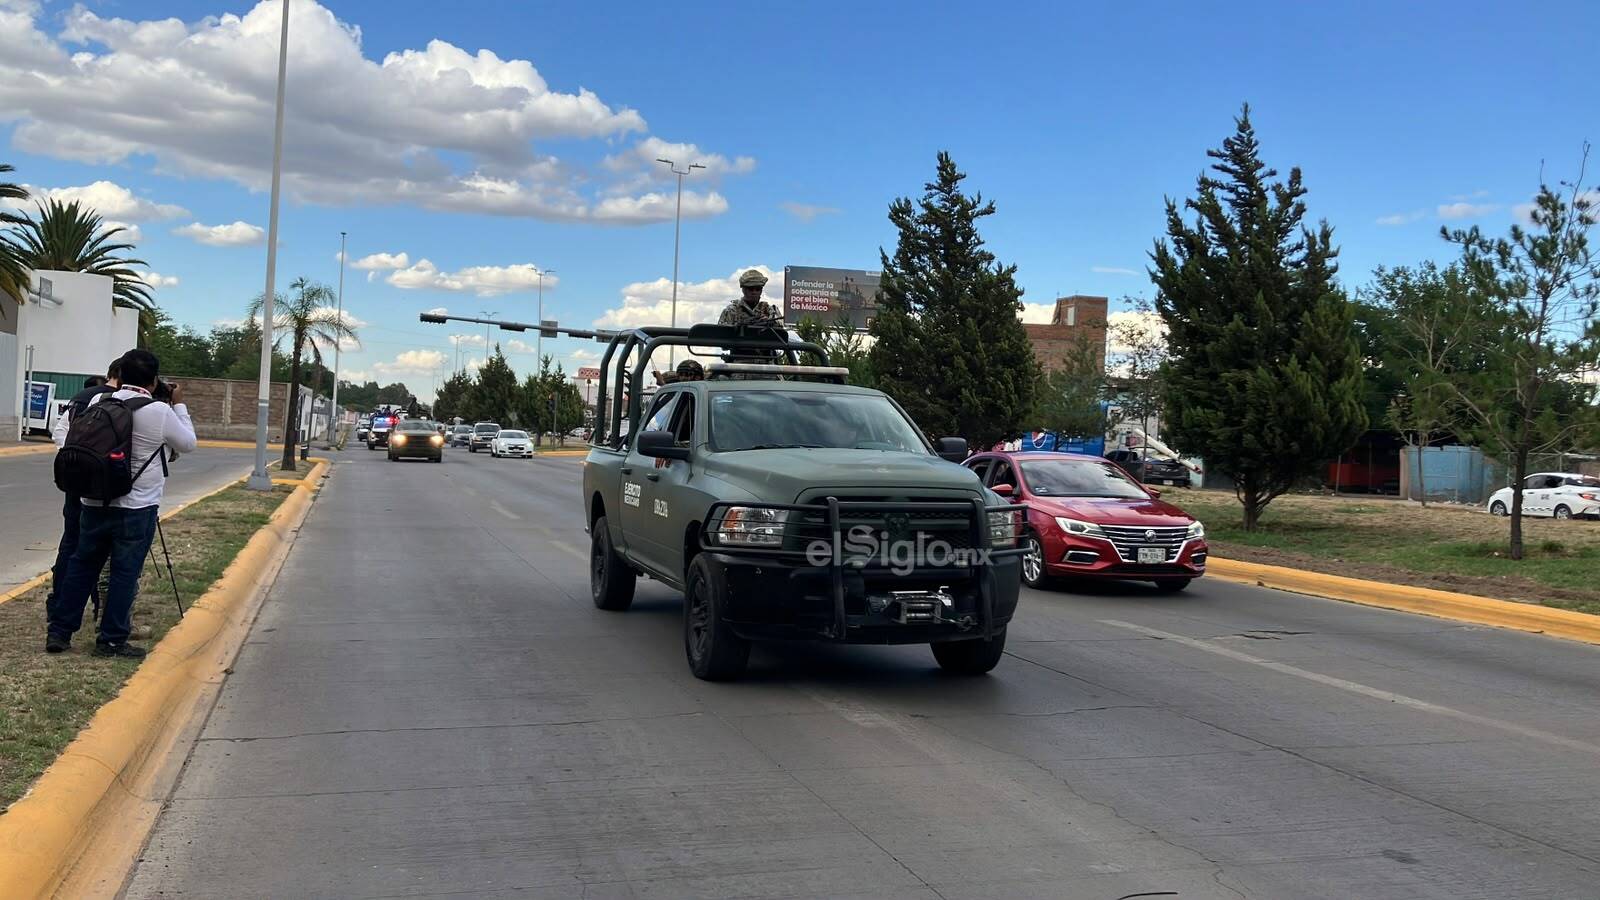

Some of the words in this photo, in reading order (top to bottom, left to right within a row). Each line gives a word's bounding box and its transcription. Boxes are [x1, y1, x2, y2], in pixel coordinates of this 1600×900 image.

[826, 281, 834, 289] la
[791, 288, 829, 296] soberanía
[812, 296, 829, 304] bien
[802, 303, 828, 311] México
